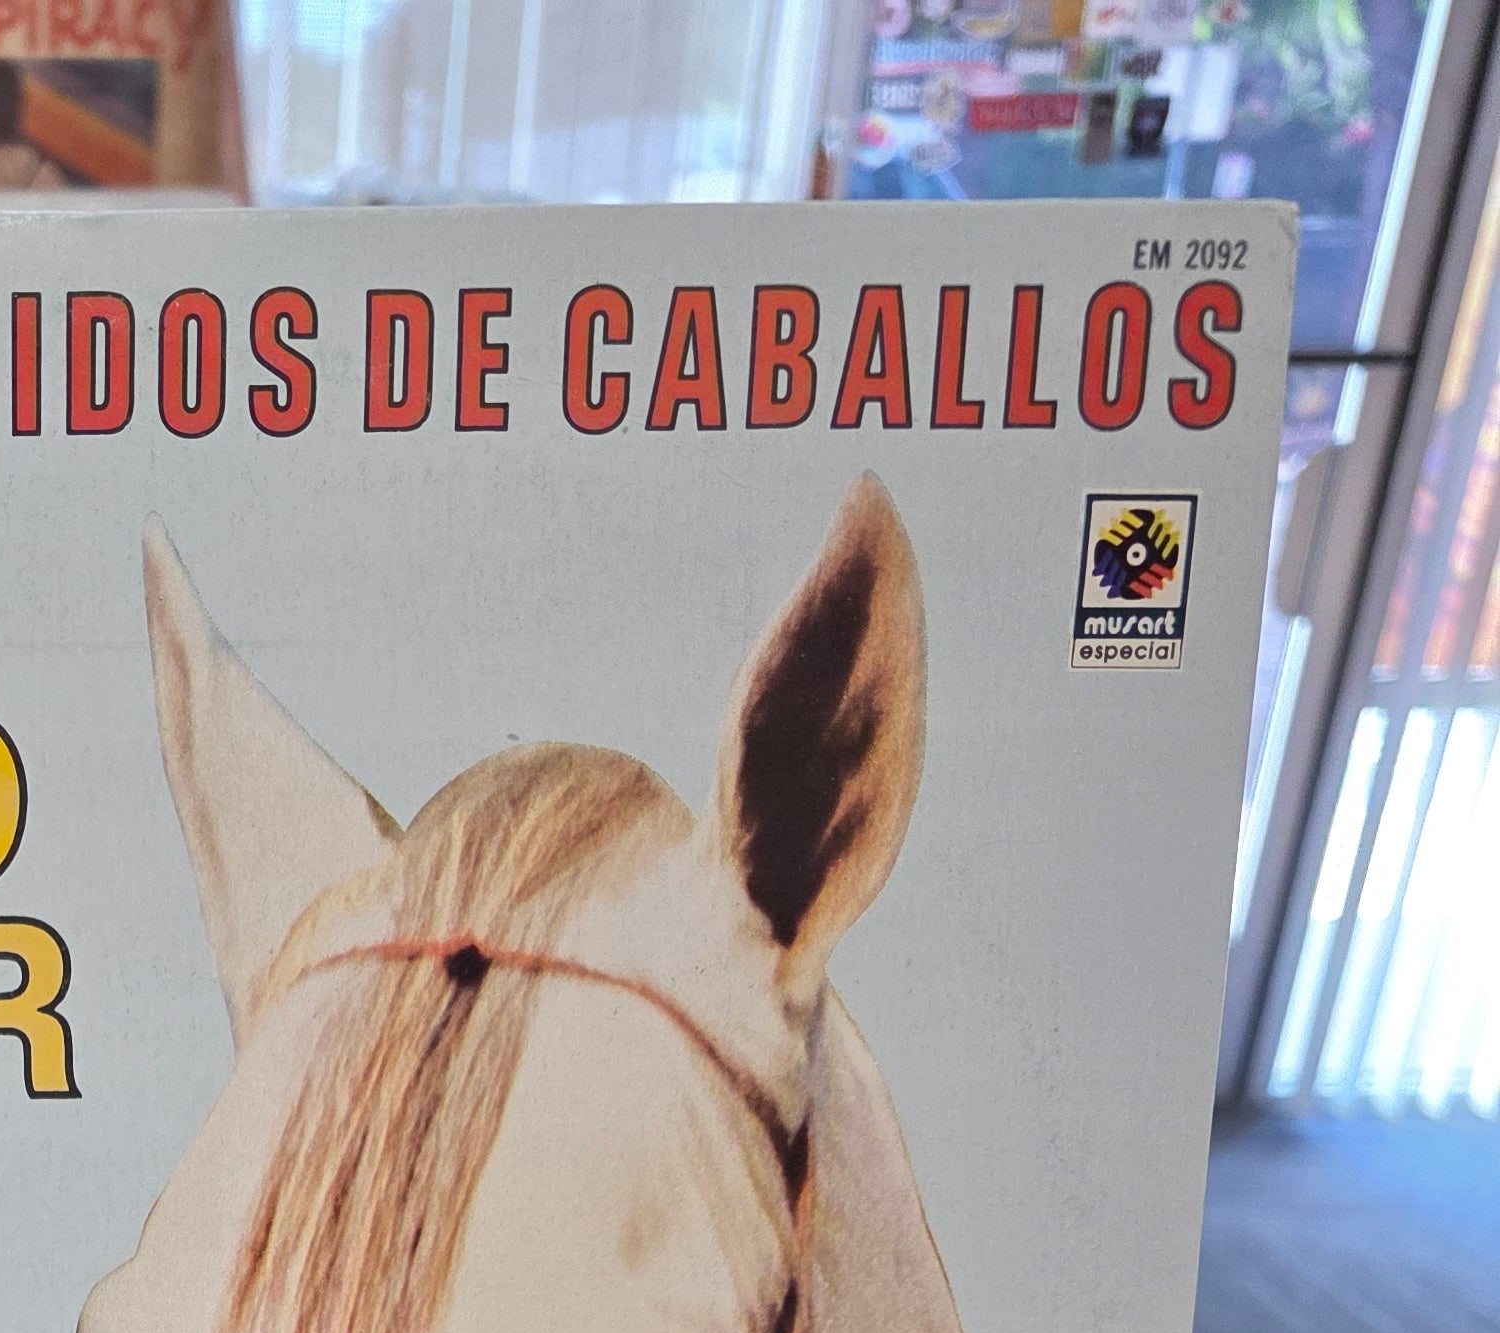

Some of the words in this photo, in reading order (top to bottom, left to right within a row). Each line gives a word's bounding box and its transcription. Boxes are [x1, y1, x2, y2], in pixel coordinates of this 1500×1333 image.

[1133, 239, 1172, 271] EM
[1184, 238, 1249, 271] 2092
[363, 287, 513, 433] DE
[561, 279, 1243, 436] CABALLOS
[1083, 610, 1176, 635] musart
[1079, 641, 1176, 664] especial
